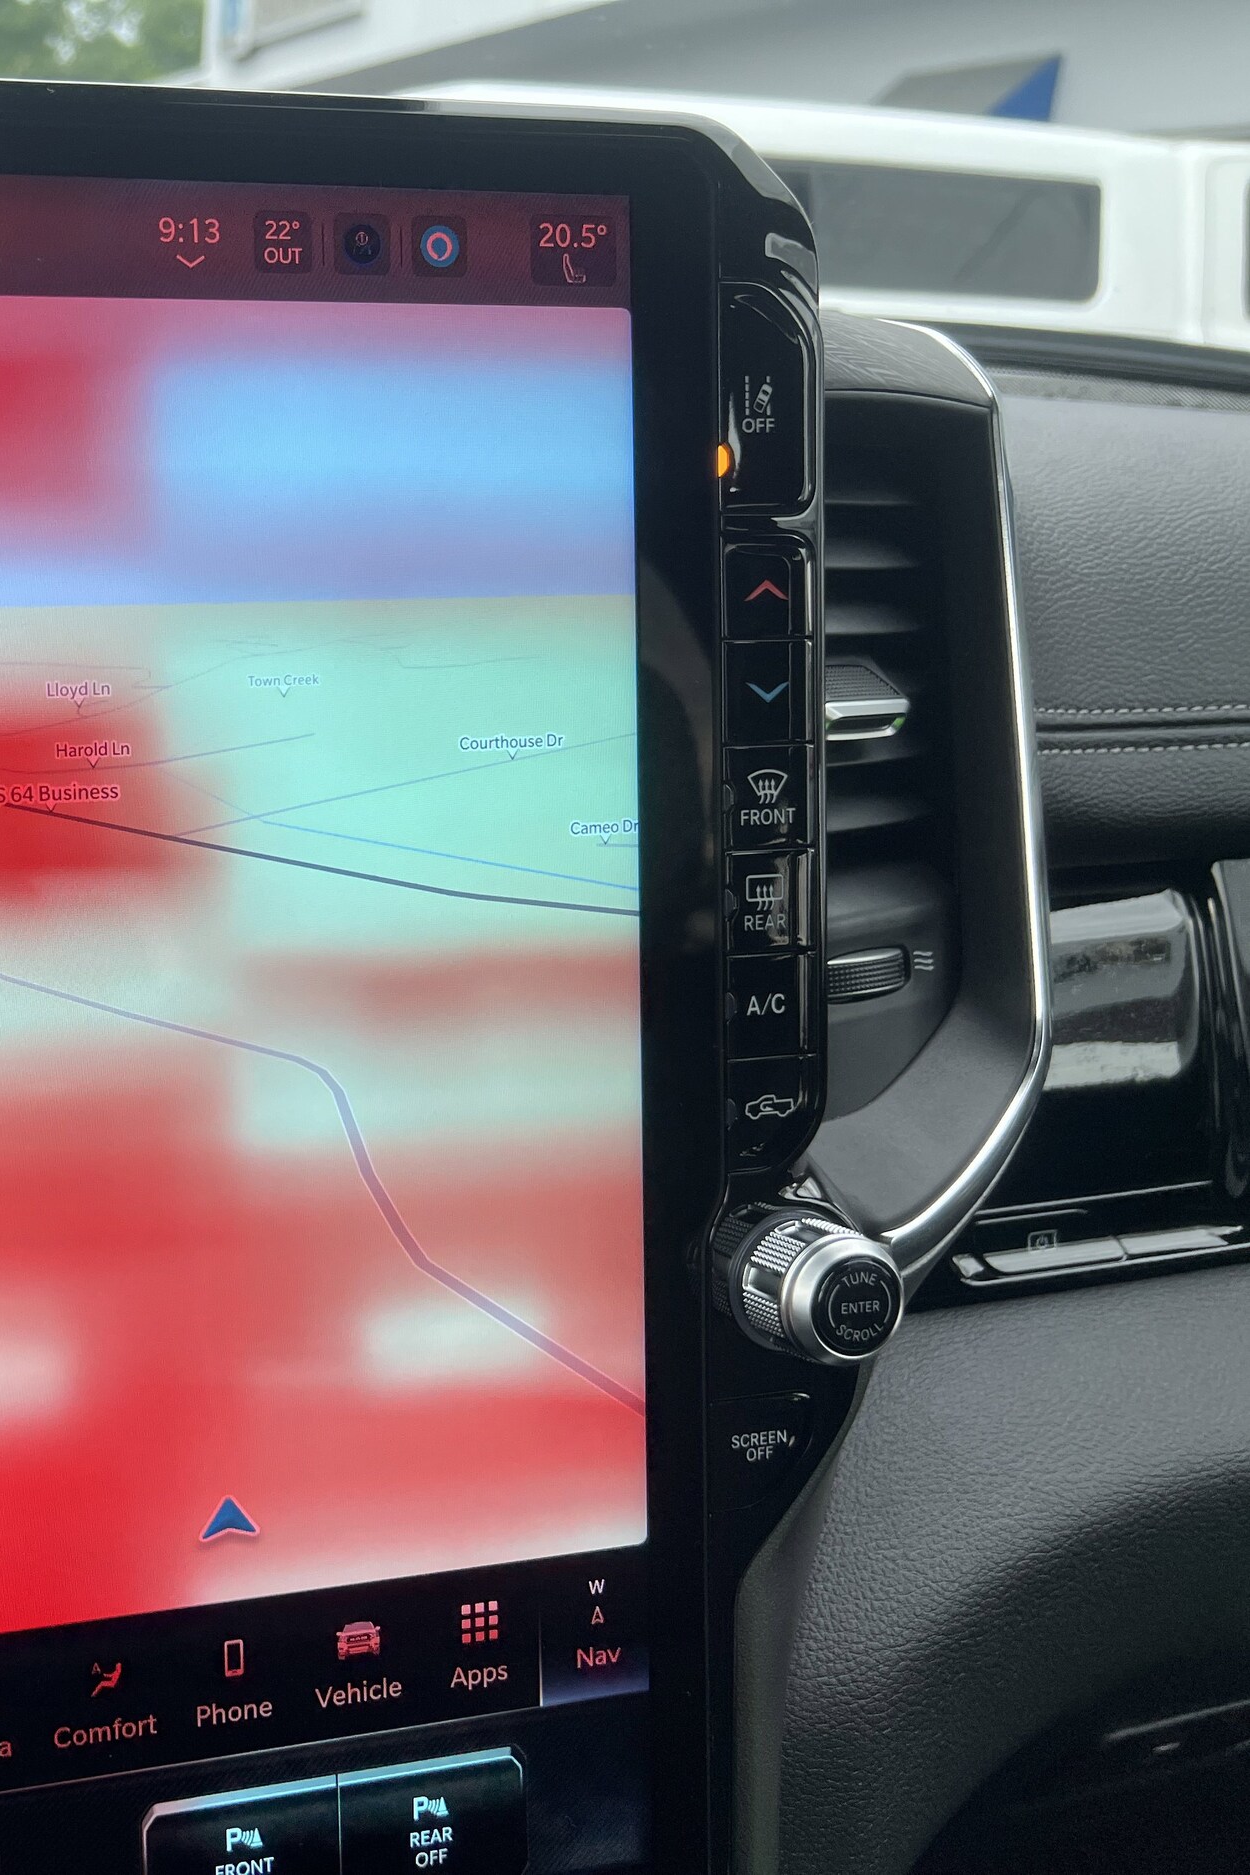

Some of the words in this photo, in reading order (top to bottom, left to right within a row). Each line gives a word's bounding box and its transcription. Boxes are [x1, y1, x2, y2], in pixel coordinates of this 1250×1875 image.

[158, 216, 220, 244] 9:13
[264, 220, 300, 241] 22°
[539, 223, 607, 250] 20.5°
[264, 247, 302, 265] OUT
[742, 418, 775, 433] OFF
[248, 675, 281, 687] Town
[283, 674, 319, 686] Creek
[46, 682, 88, 700] Lloyd
[92, 682, 111, 697] Ln
[56, 742, 108, 758] Harold
[113, 741, 130, 756] Ln
[459, 734, 543, 750] Courthouse
[546, 733, 565, 748] Dr
[10, 786, 34, 803] 64
[38, 784, 119, 802] Business
[740, 807, 796, 826] FRONT
[570, 821, 619, 835] Cameo
[744, 914, 786, 931] REAR
[746, 993, 785, 1016] A/C
[841, 1271, 878, 1288] TUNE
[840, 1300, 880, 1315] ENTER
[835, 1323, 884, 1342] SCROLL
[731, 1429, 787, 1449] SCREEN
[746, 1446, 773, 1462] OFF
[588, 1579, 605, 1594] W
[576, 1646, 621, 1668] Nav
[54, 1714, 157, 1749] Comfort
[196, 1700, 273, 1728] Phone
[315, 1677, 403, 1709] Vehicle
[450, 1663, 508, 1691] Apps
[409, 1826, 453, 1849] REAR
[214, 1857, 275, 1875] FRONT
[415, 1848, 448, 1868] OFF
